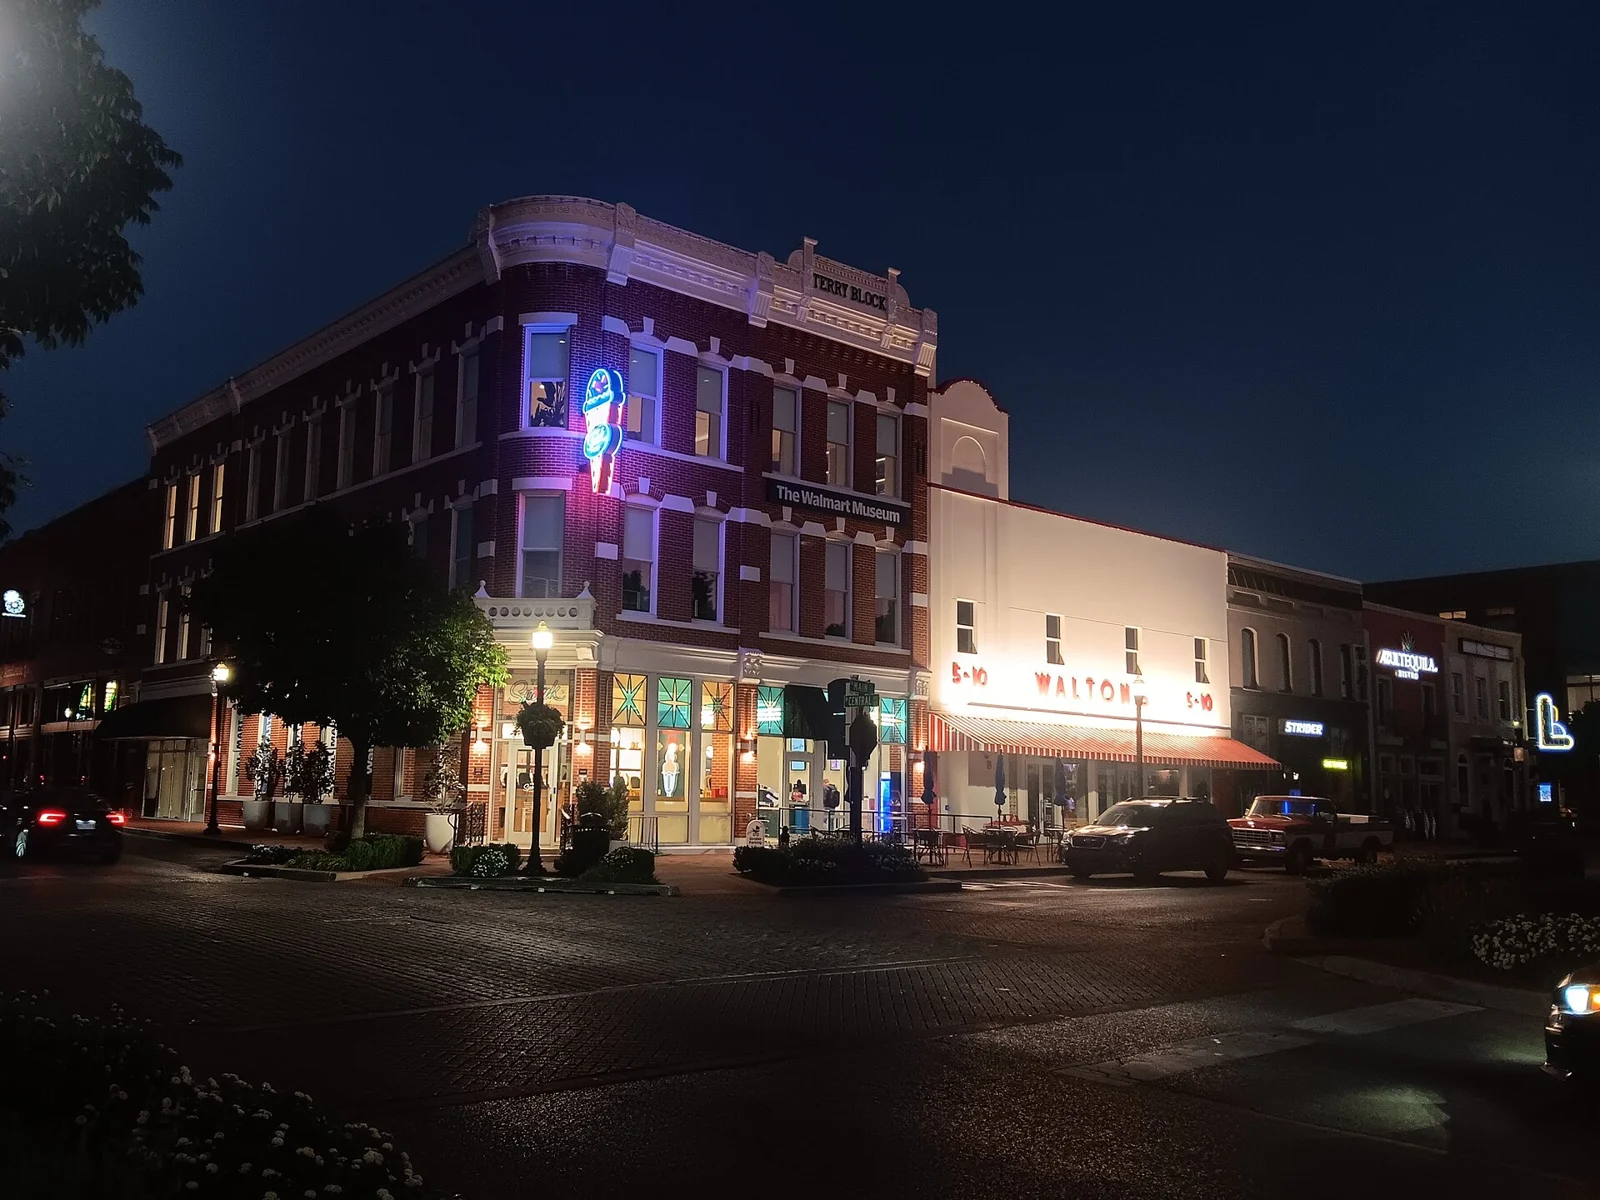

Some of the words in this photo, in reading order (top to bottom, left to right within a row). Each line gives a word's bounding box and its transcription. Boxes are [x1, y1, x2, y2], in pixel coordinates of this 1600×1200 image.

[813, 272, 848, 298] TERRY
[851, 286, 886, 311] BLOCK
[777, 485, 800, 502] The
[801, 489, 851, 513] Walmart
[852, 500, 900, 523] Museum
[854, 681, 868, 692] MAIN
[952, 661, 988, 687] 5-10
[1186, 691, 1213, 712] 5-10
[848, 696, 871, 706] CENTRAL
[1284, 721, 1323, 736] STRIDER
